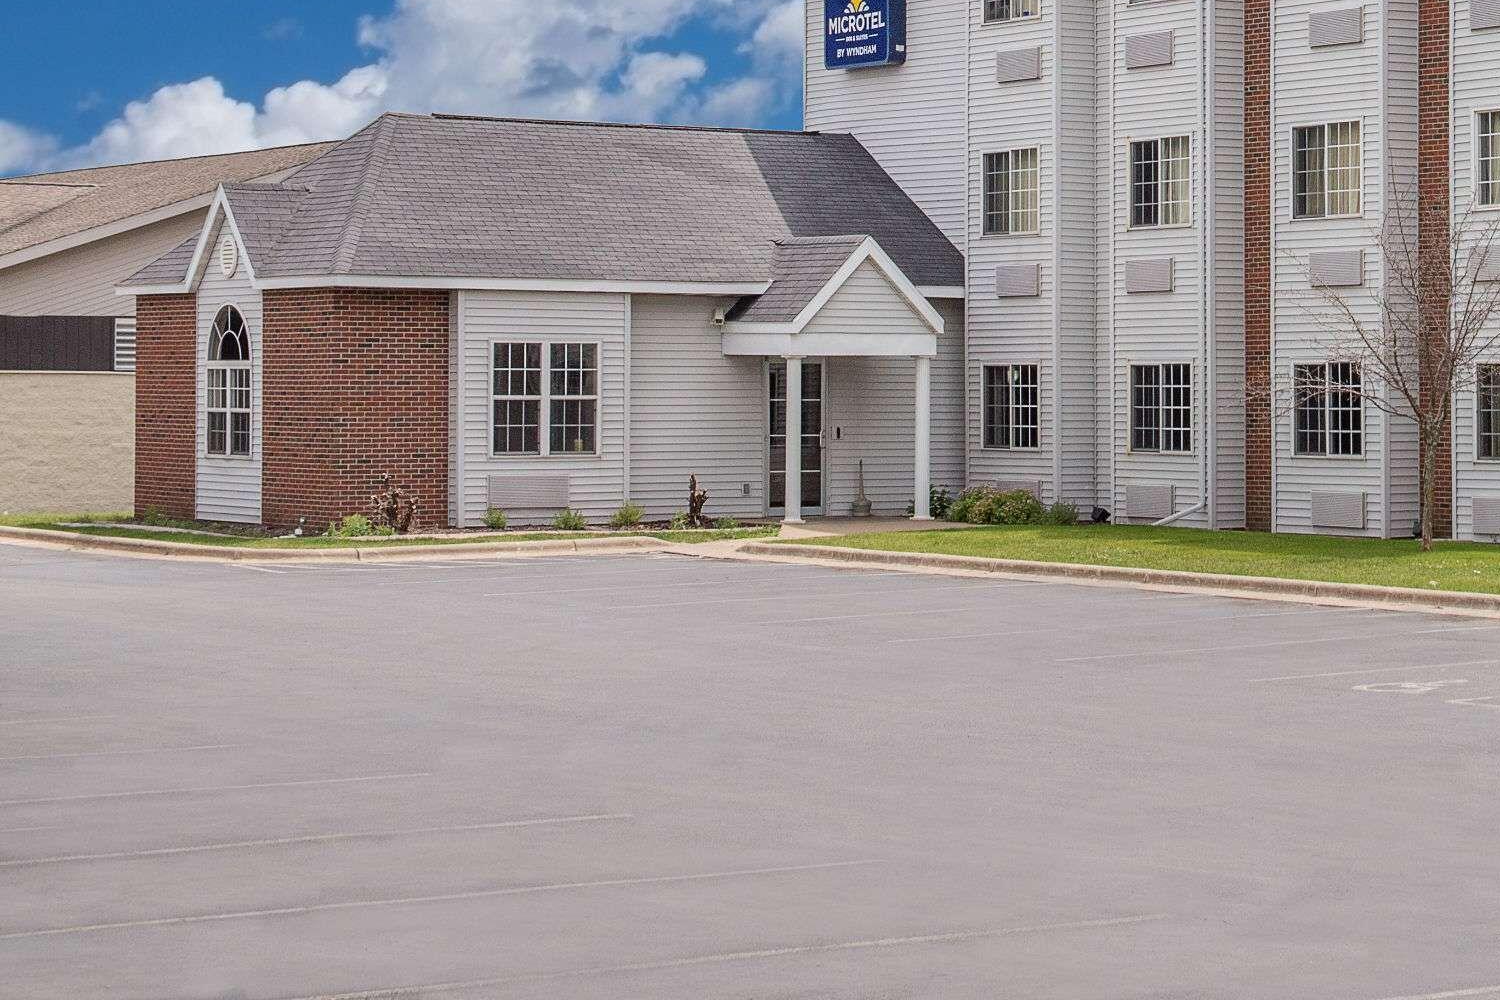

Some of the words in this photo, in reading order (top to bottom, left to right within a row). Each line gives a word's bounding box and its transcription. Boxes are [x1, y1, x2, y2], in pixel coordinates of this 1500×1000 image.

[829, 11, 885, 35] MICROTEL
[837, 48, 845, 58] BY
[847, 44, 877, 56] WYNDHAM
